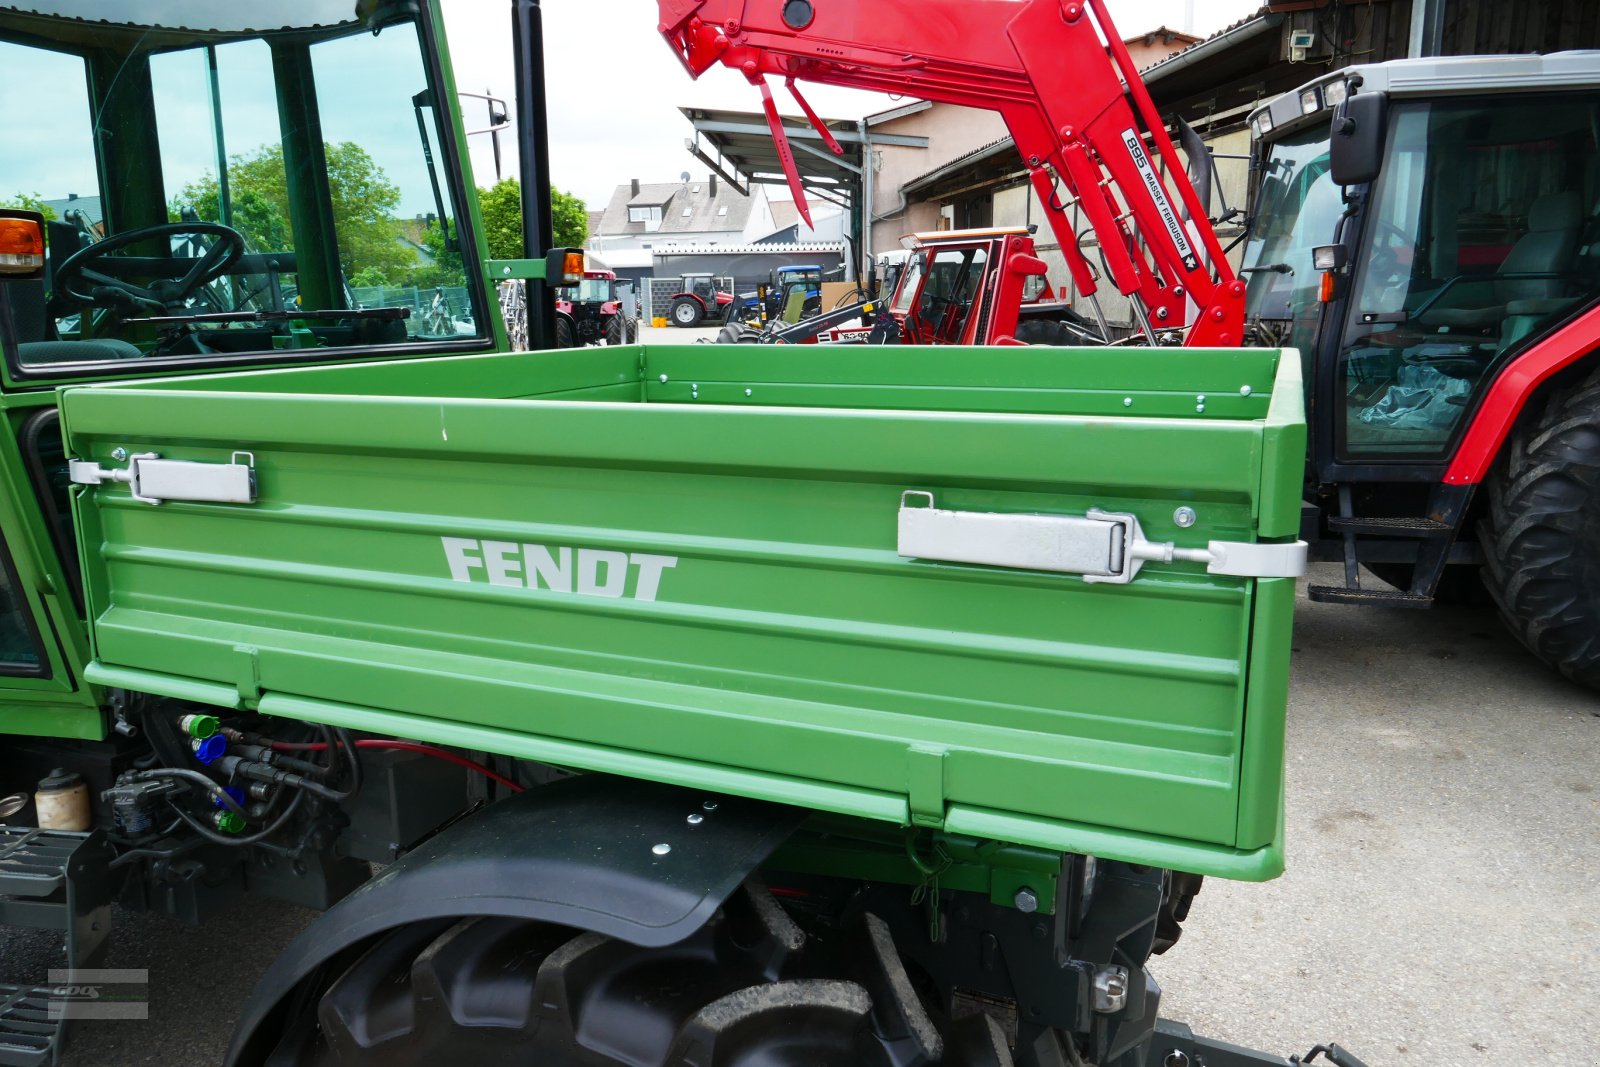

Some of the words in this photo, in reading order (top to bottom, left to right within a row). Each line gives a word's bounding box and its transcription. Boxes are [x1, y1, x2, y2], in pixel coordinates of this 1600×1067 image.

[1127, 137, 1147, 168] 895
[1145, 172, 1165, 206] MASSEY
[1162, 208, 1187, 251] FERGUSON
[441, 536, 678, 602] FENDT
